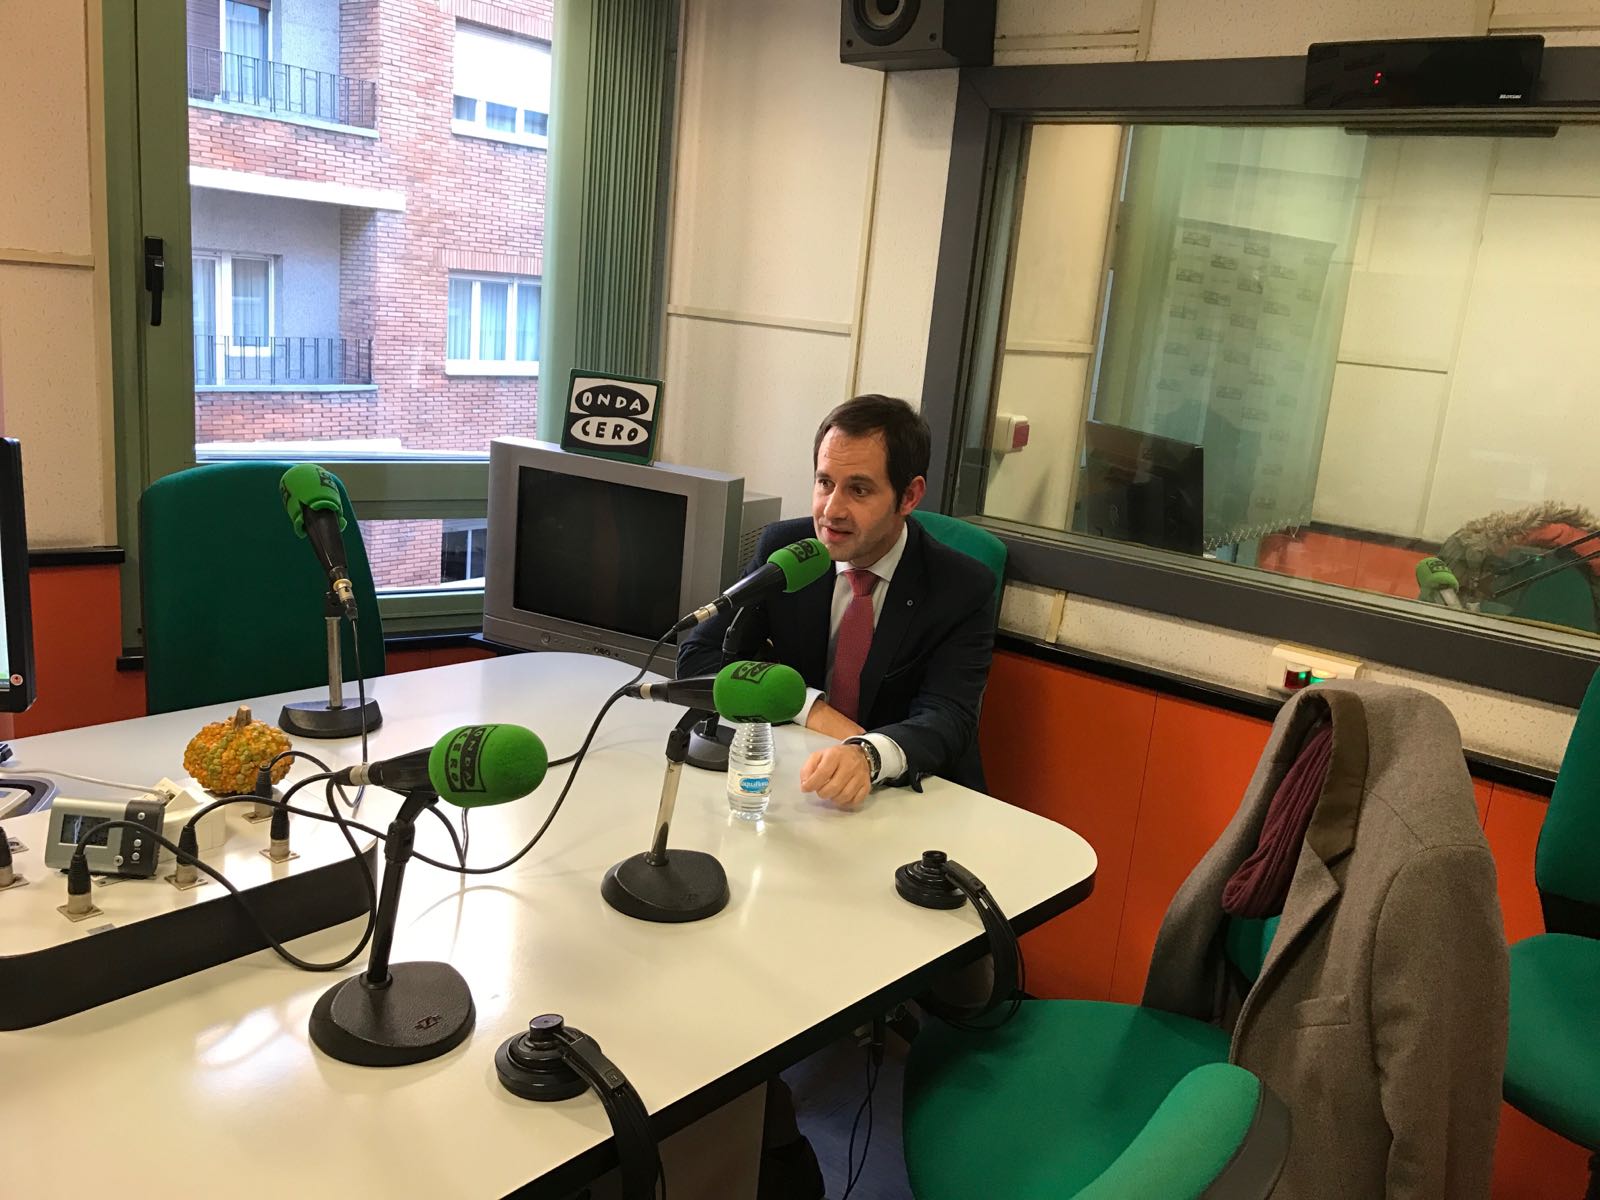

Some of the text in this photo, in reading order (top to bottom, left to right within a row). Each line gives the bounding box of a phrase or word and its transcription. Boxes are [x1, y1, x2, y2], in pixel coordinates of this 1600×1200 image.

[582, 391, 641, 412] ONDA
[581, 420, 639, 442] CERO
[449, 732, 468, 782] CERO
[463, 729, 483, 781] ONDA
